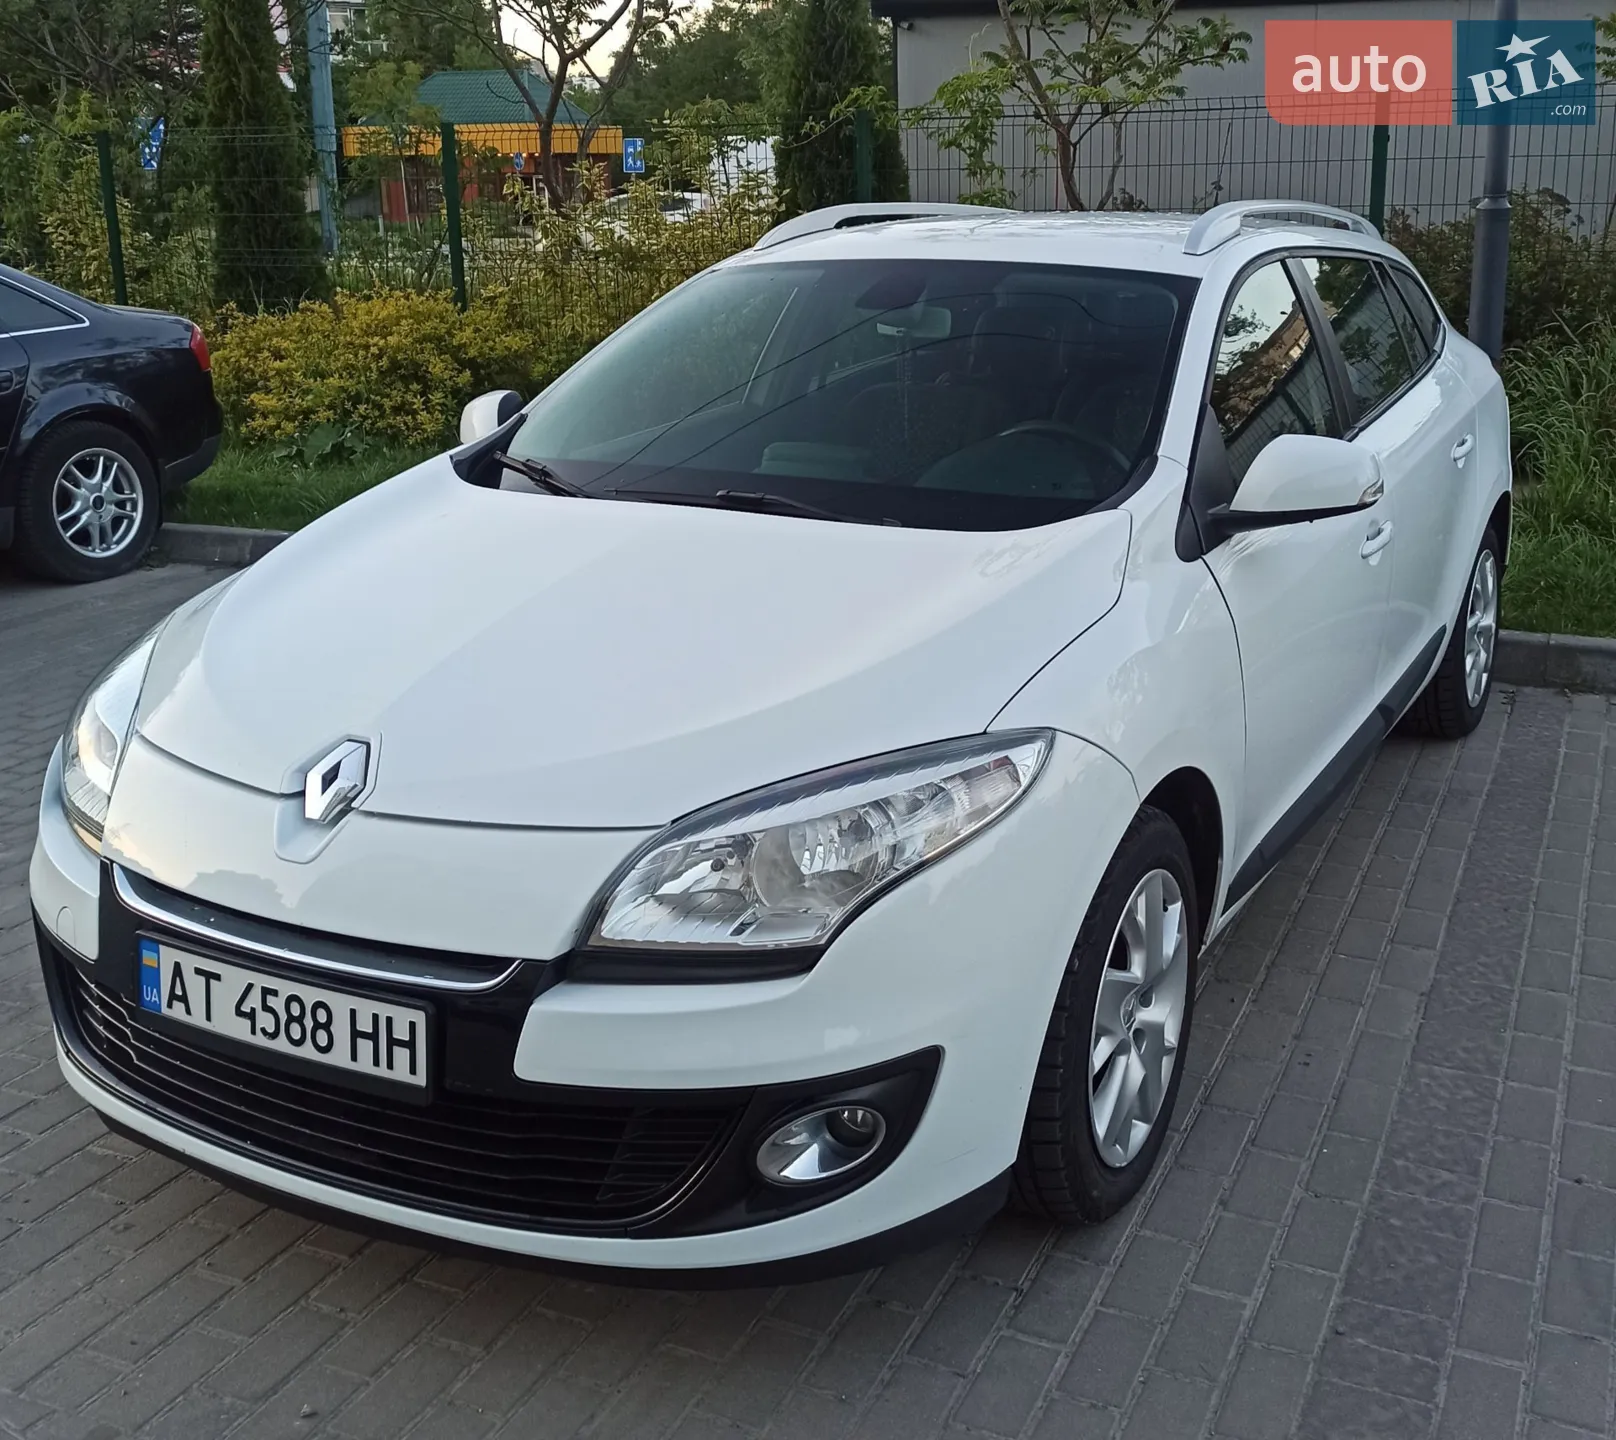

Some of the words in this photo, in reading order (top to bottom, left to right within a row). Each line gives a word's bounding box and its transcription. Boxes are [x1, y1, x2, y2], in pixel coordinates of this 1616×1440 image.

[143, 985, 160, 1005] UA
[166, 960, 222, 1023] AT
[234, 981, 334, 1054] 4588
[349, 1007, 417, 1076] HH
